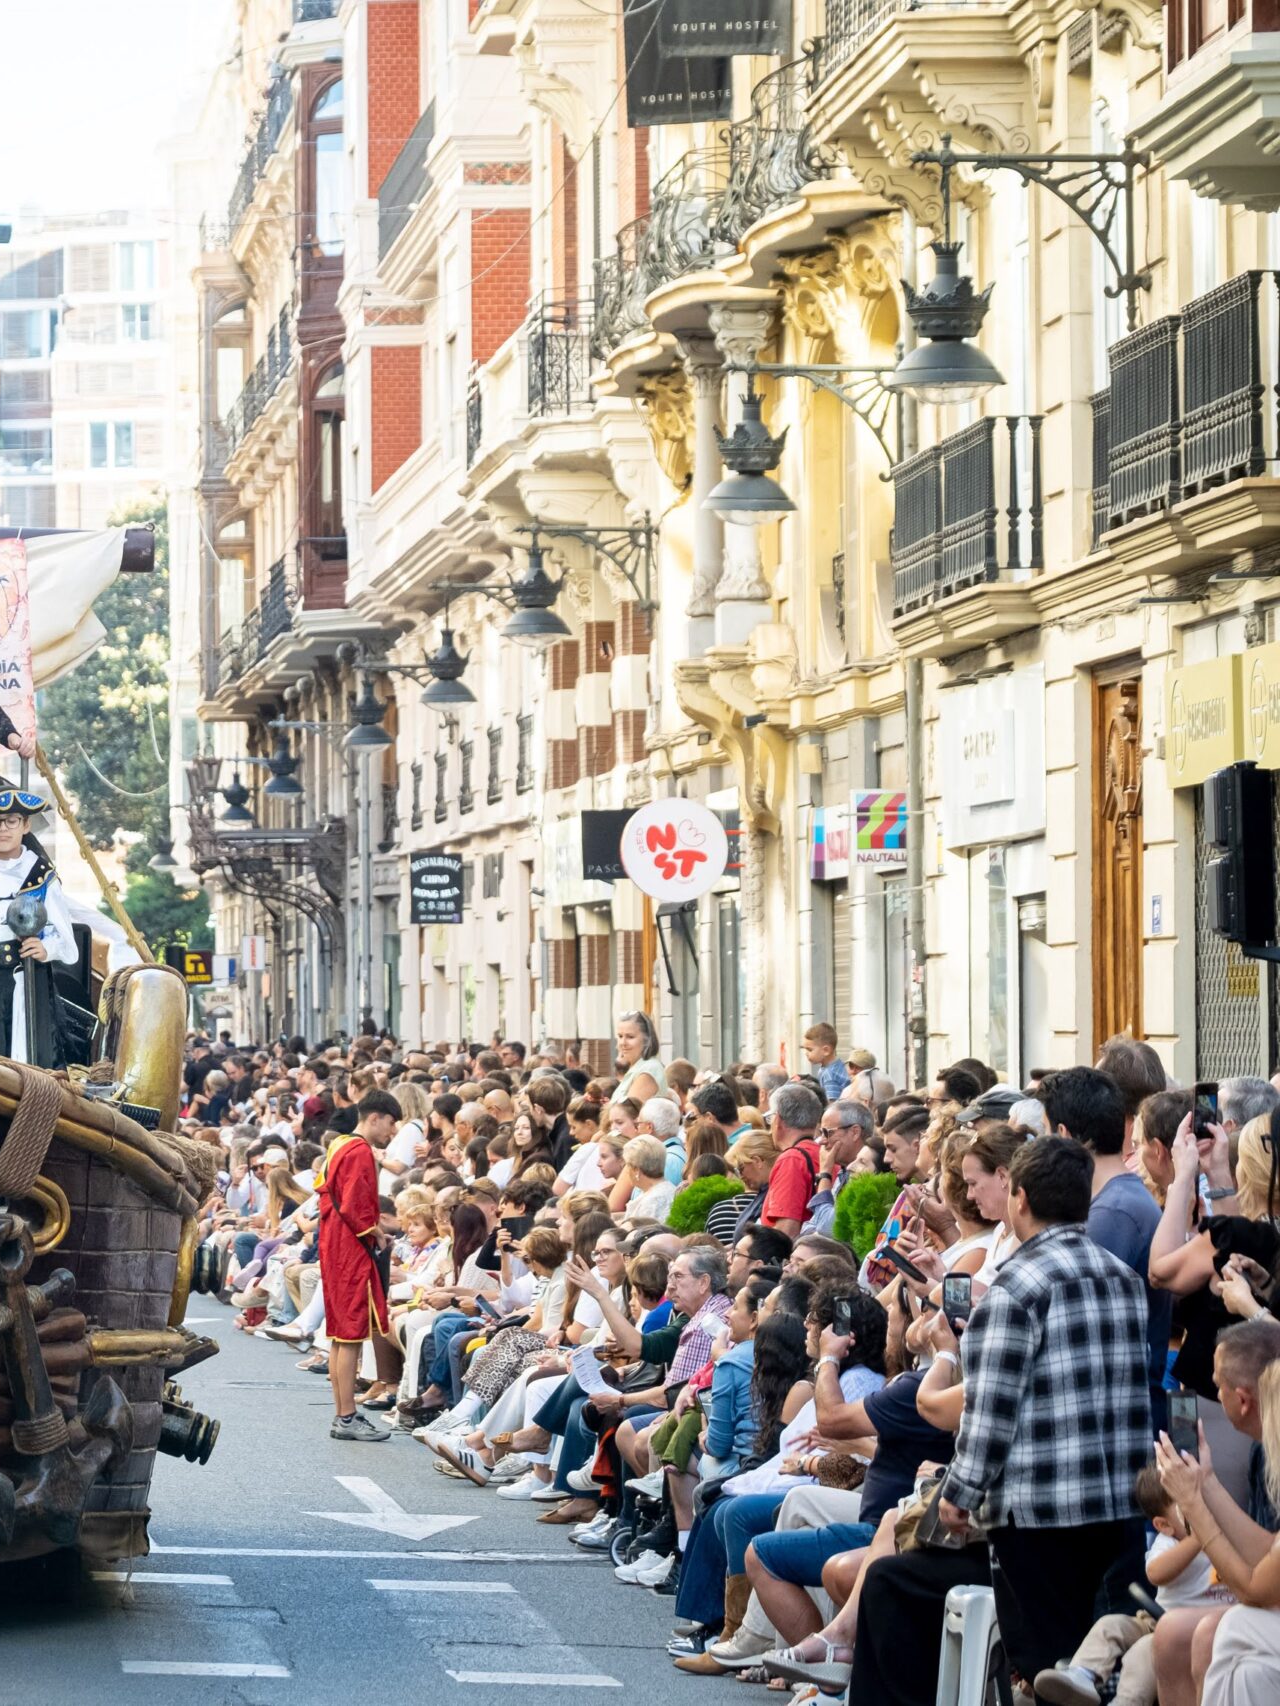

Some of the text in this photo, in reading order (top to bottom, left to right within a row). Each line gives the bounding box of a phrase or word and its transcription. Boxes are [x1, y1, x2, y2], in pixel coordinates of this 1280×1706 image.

[672, 20, 779, 32] YOUTH HOSTEL
[641, 89, 732, 104] YOUTH HOSTE
[411, 856, 462, 872] RESTAURANTE
[587, 864, 620, 874] PASC
[421, 874, 450, 884] CHINO
